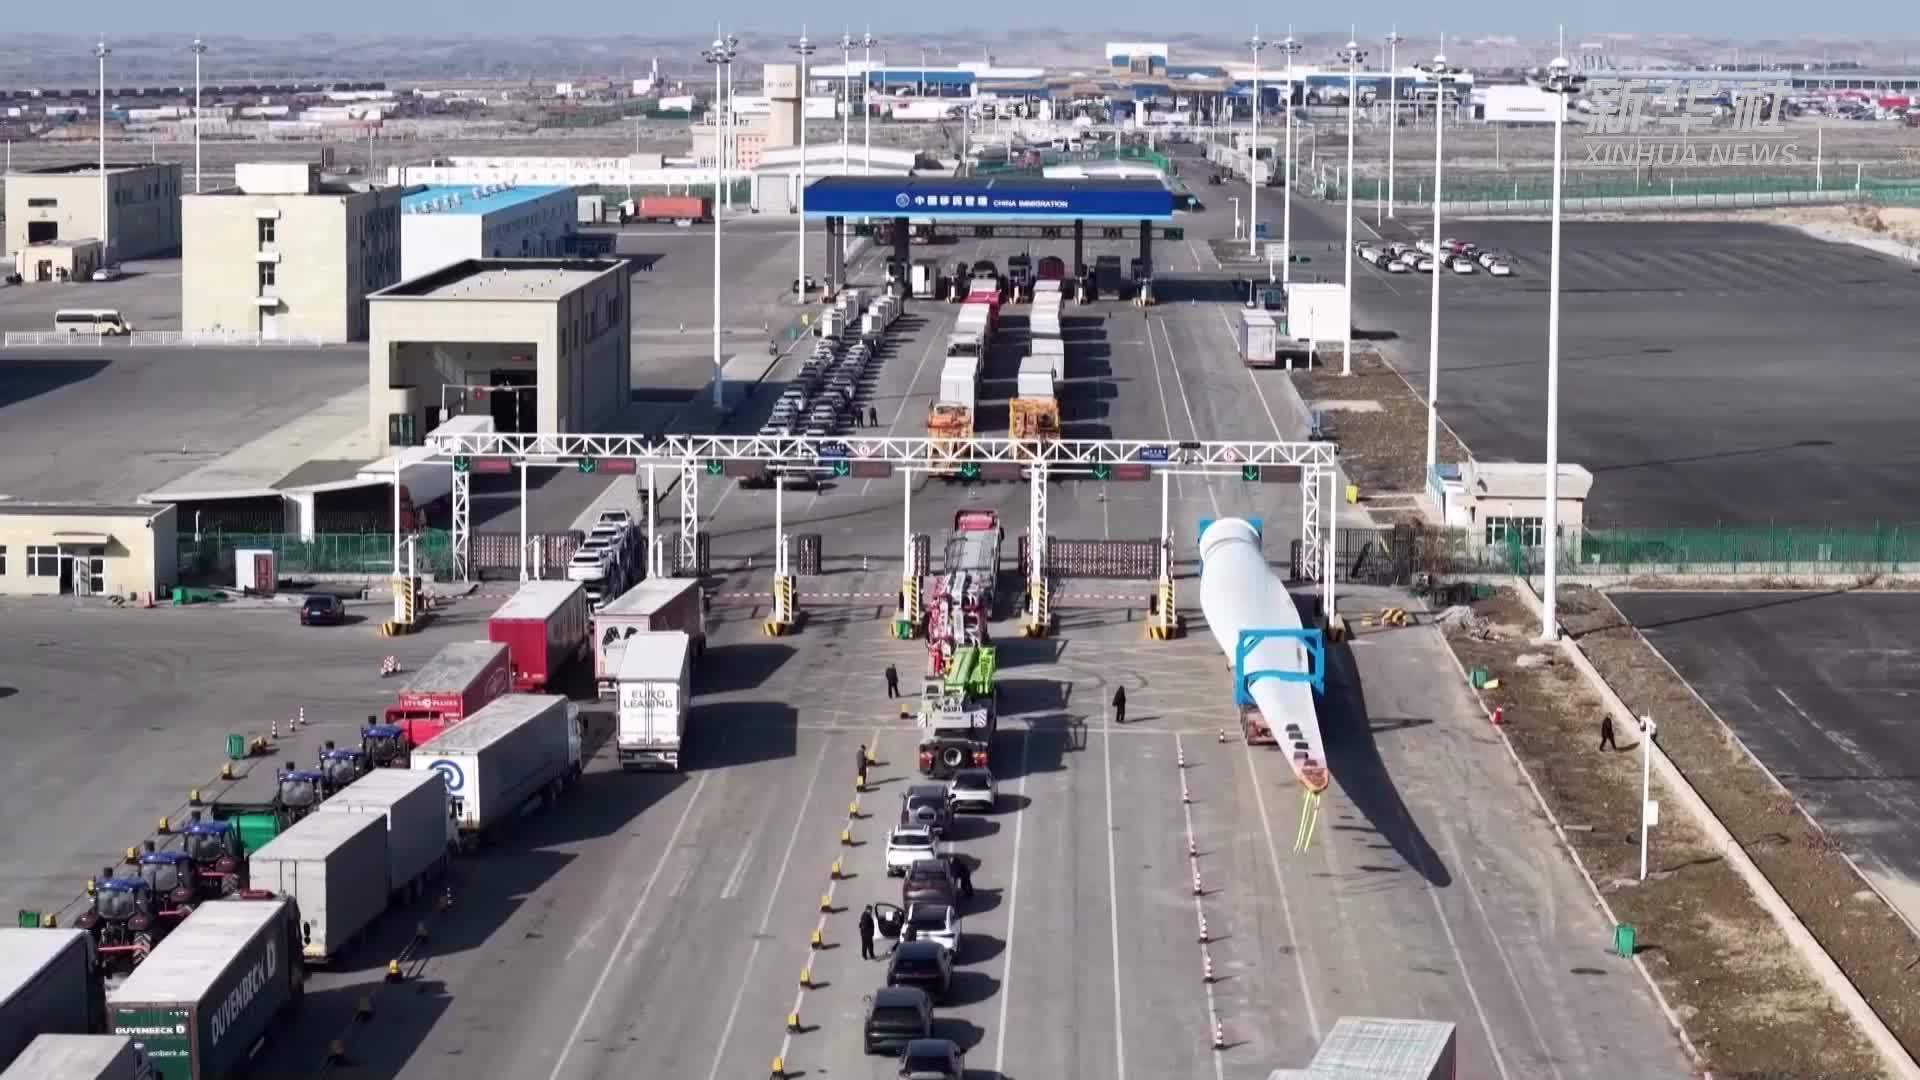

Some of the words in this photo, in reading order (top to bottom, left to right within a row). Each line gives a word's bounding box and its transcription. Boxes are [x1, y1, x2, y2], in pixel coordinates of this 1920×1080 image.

[993, 199, 1017, 208] CHINA
[1019, 200, 1068, 208] IMMIGRATION
[631, 689, 665, 699] EURO
[623, 699, 673, 709] LEASING
[210, 955, 266, 1048] DUVENBECK
